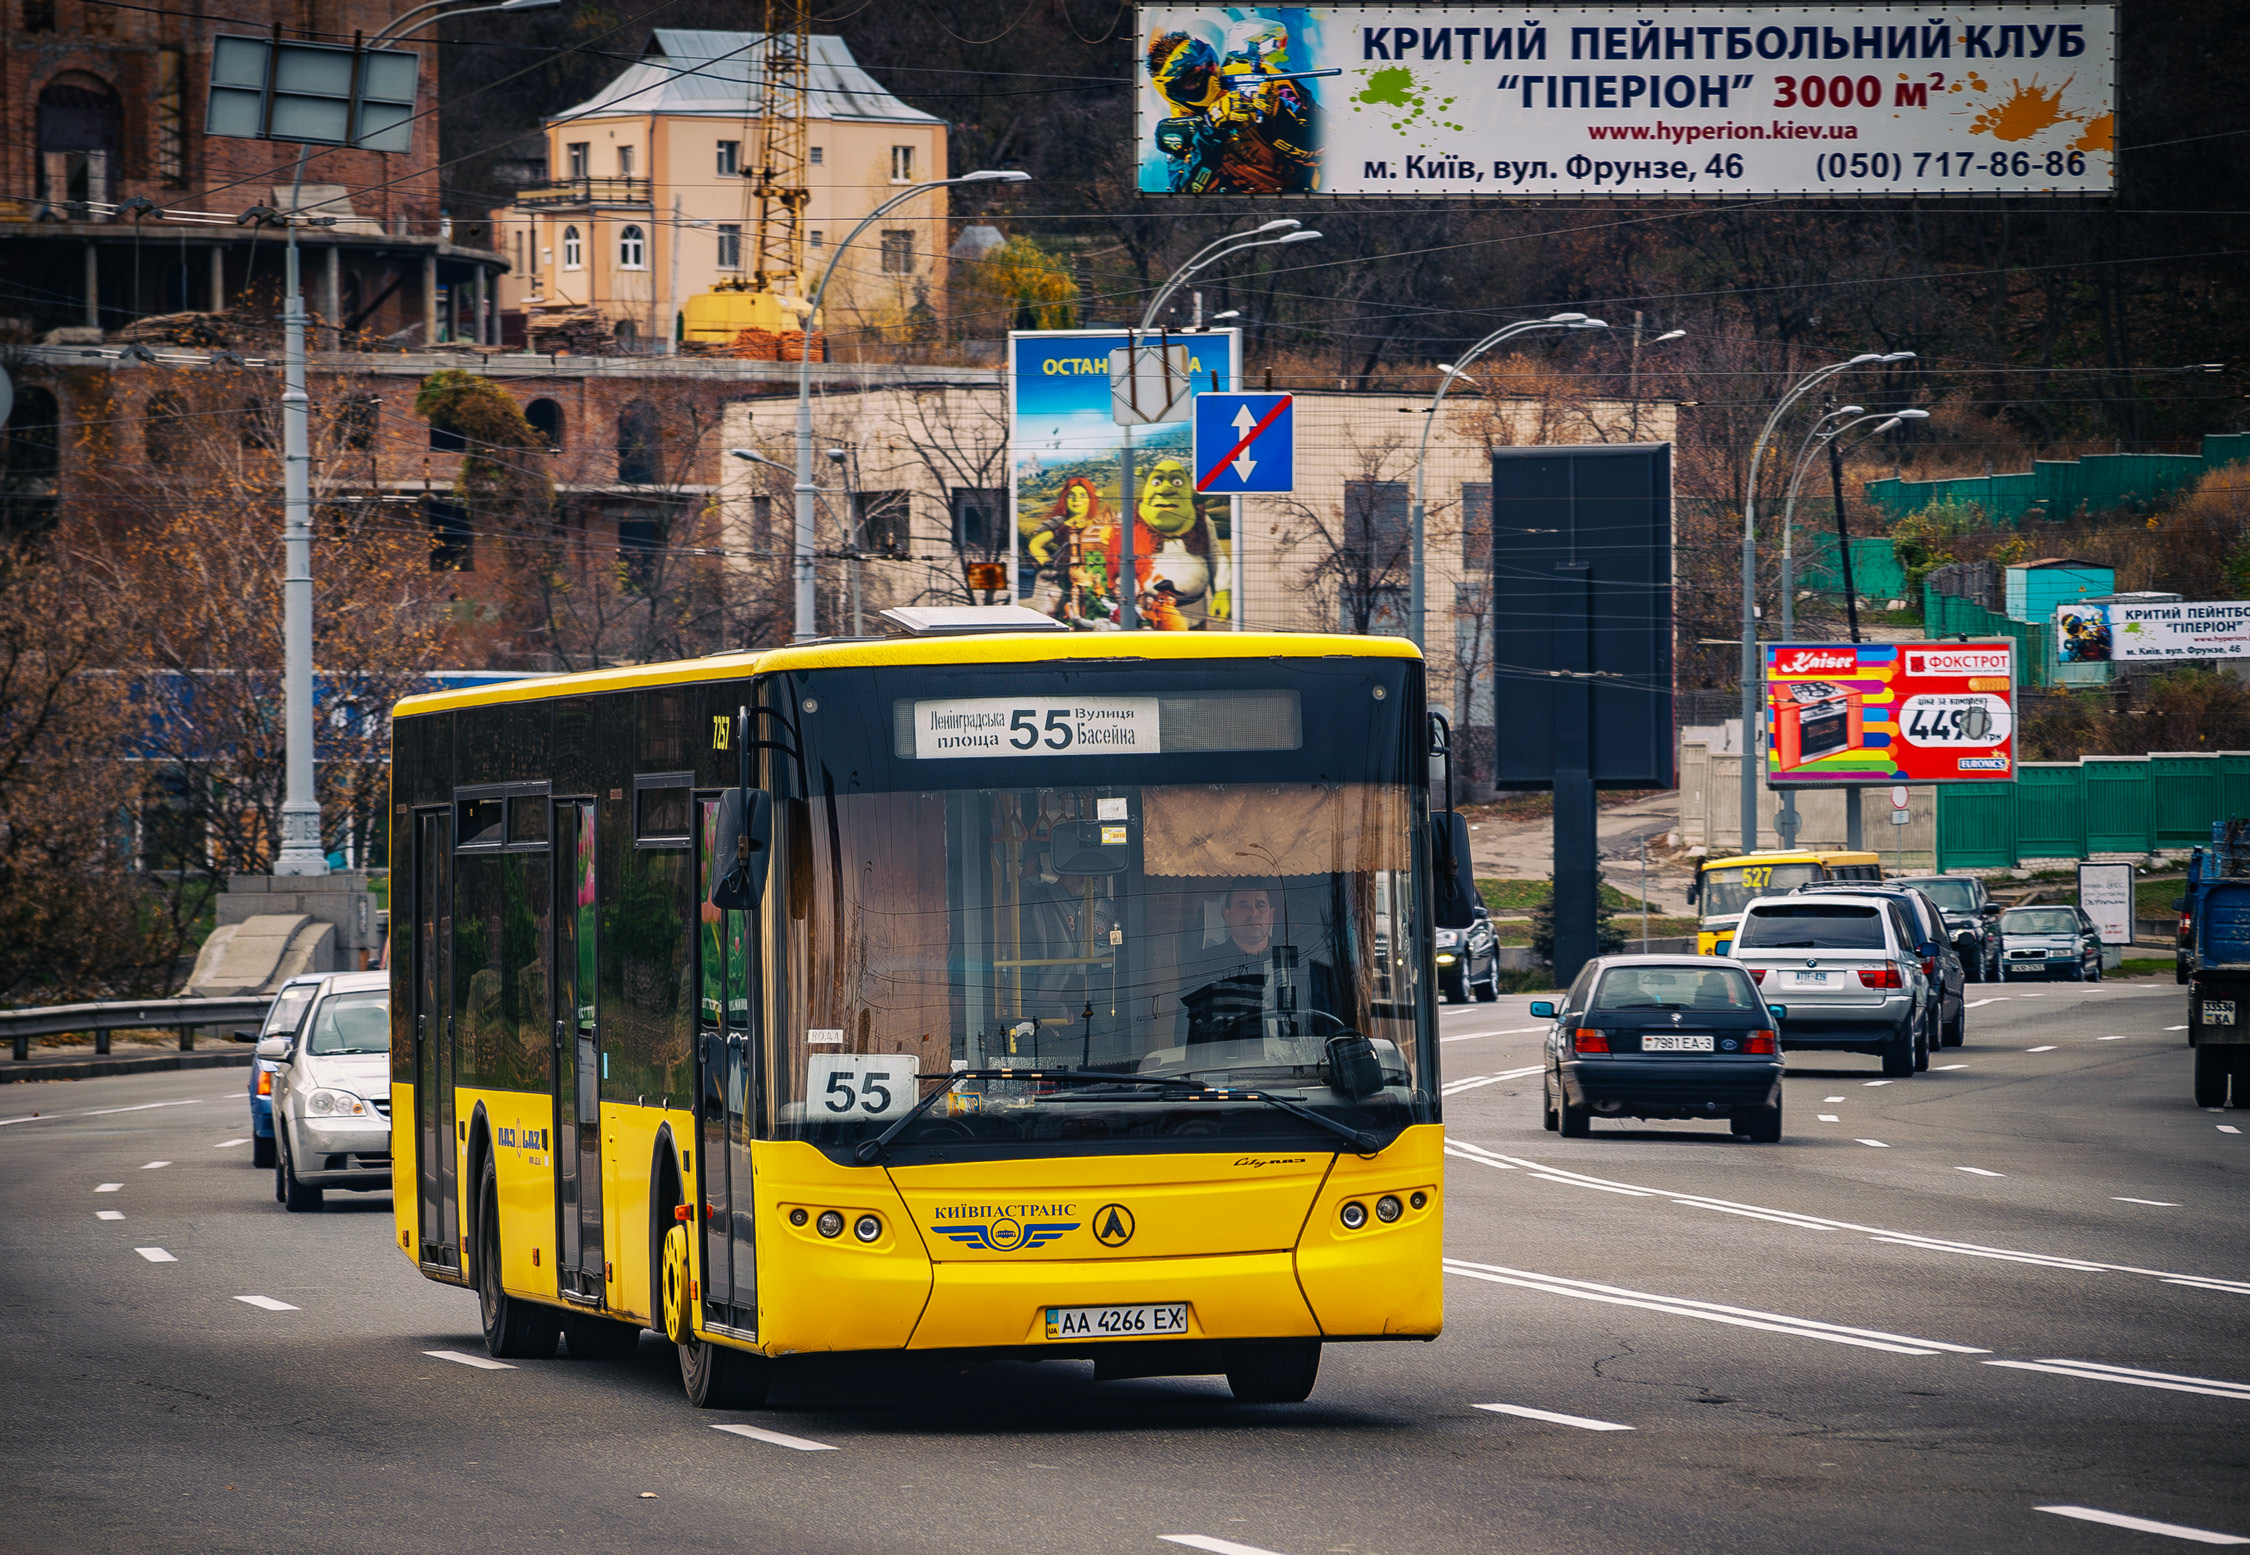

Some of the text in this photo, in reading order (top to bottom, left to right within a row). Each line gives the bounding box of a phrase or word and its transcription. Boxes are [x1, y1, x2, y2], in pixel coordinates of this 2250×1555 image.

[1361, 18, 2086, 61] КРИТИЙ ПЕЙНТБОЛЬНИЙ КЛУБ
[1497, 74, 1754, 109] “ГІПЕРІОН”
[1773, 75, 1883, 109] 3000
[1587, 121, 1858, 145] www.hyperion.kiev.ua
[1363, 153, 1744, 187] м. Київ, вул. Фрунзе, 46
[1816, 151, 2086, 184] (050) 717-86-86
[1042, 358, 1108, 375] ОСТАН
[2125, 607, 2181, 620] КРИТИЙ
[1781, 650, 1855, 673] Kaiser
[1929, 655, 2008, 668] ФОКСТРОТ
[930, 710, 1006, 733] Ленінградська
[1075, 707, 1135, 722] Вулиця
[713, 716, 730, 750] 7257
[937, 733, 1000, 749] площа
[1009, 709, 1074, 751] 55
[1077, 723, 1136, 745] Басейна
[1961, 760, 2004, 769] EURONICS
[1742, 867, 1773, 888] 527
[825, 1071, 892, 1114] 55
[934, 1202, 1077, 1219] КИЇВПАСТРАНС
[1061, 1306, 1182, 1335] AA 4266 EX
